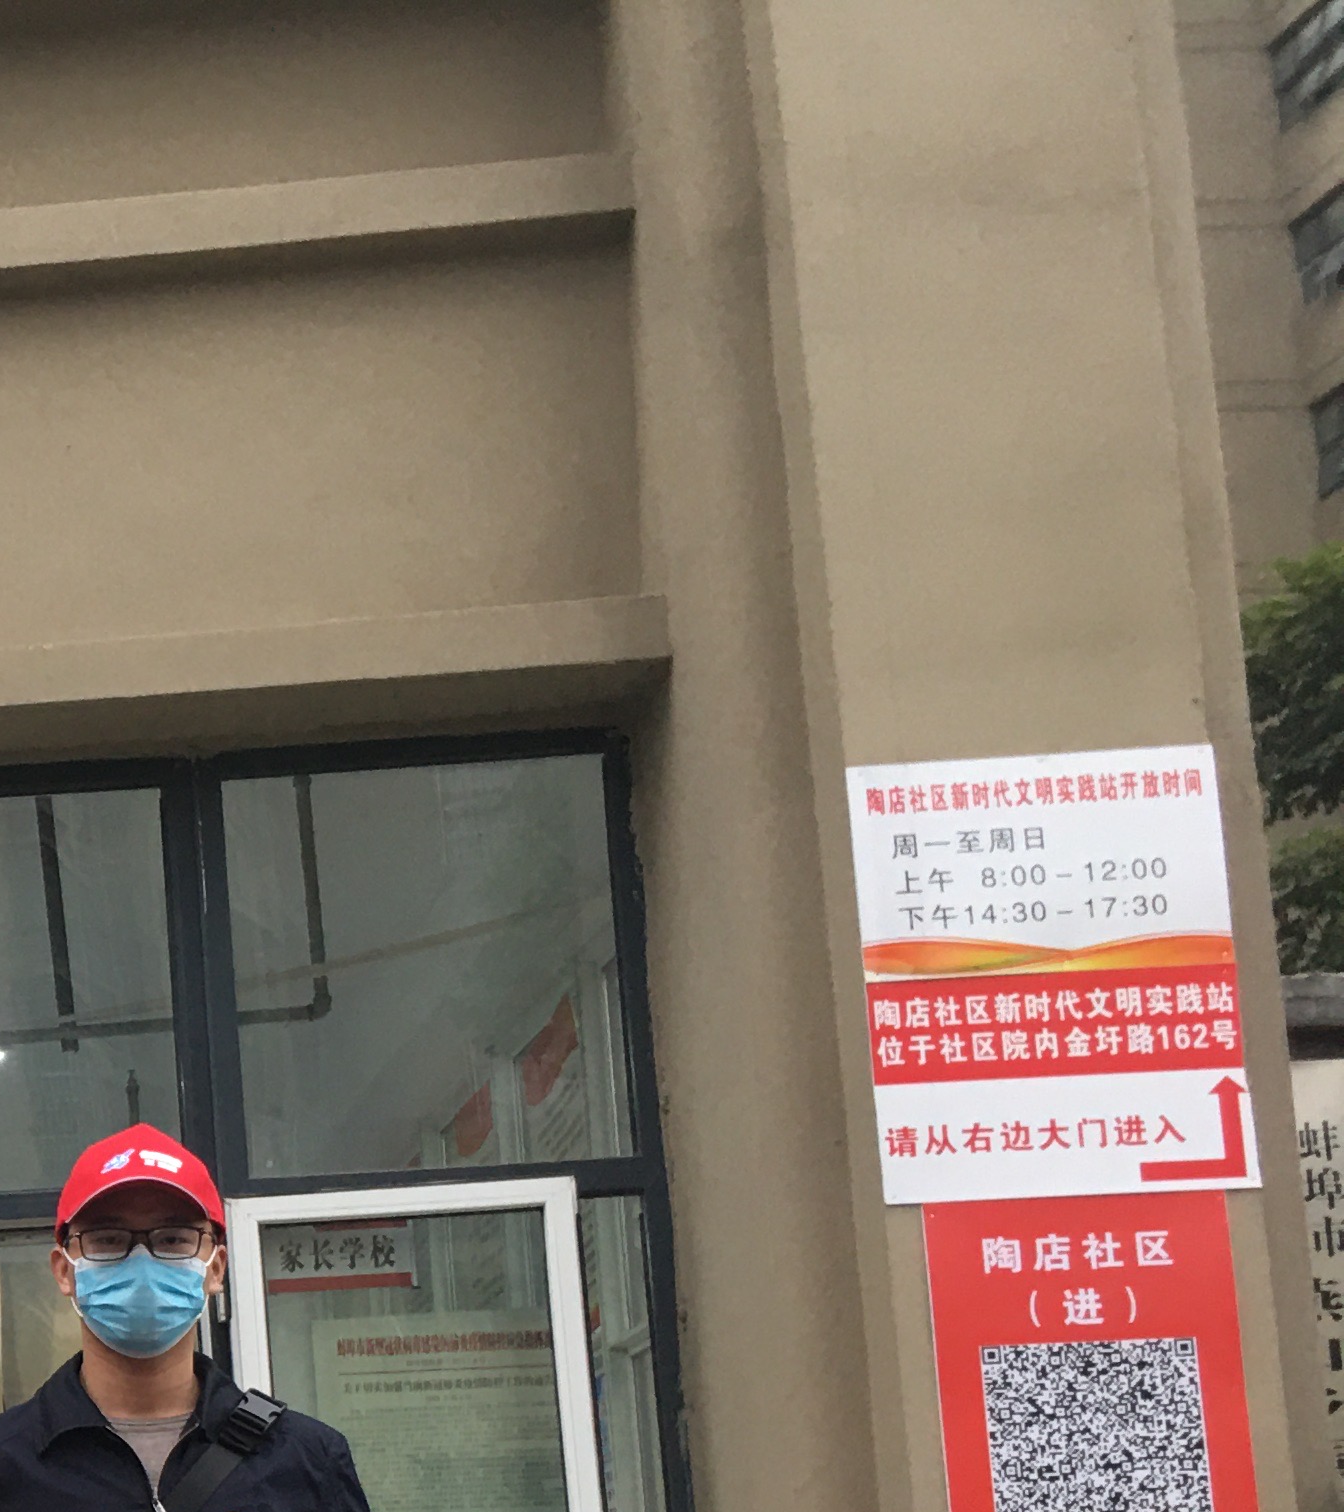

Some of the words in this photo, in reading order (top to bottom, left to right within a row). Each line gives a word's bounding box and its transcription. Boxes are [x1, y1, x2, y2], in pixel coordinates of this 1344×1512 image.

[866, 768, 1204, 816] 陶店社区新时代文明实践站开放时间
[891, 826, 1047, 860] 周一至周日
[895, 866, 955, 896] 上午
[873, 981, 1236, 1031] 陶店社区新时代文明实践站
[877, 1020, 1239, 1068] 位于社区院内金圩路162号
[885, 1113, 1187, 1158] 请从右边大门进入
[277, 1233, 397, 1275] 家长学校
[981, 1231, 1175, 1274] 陶店社区
